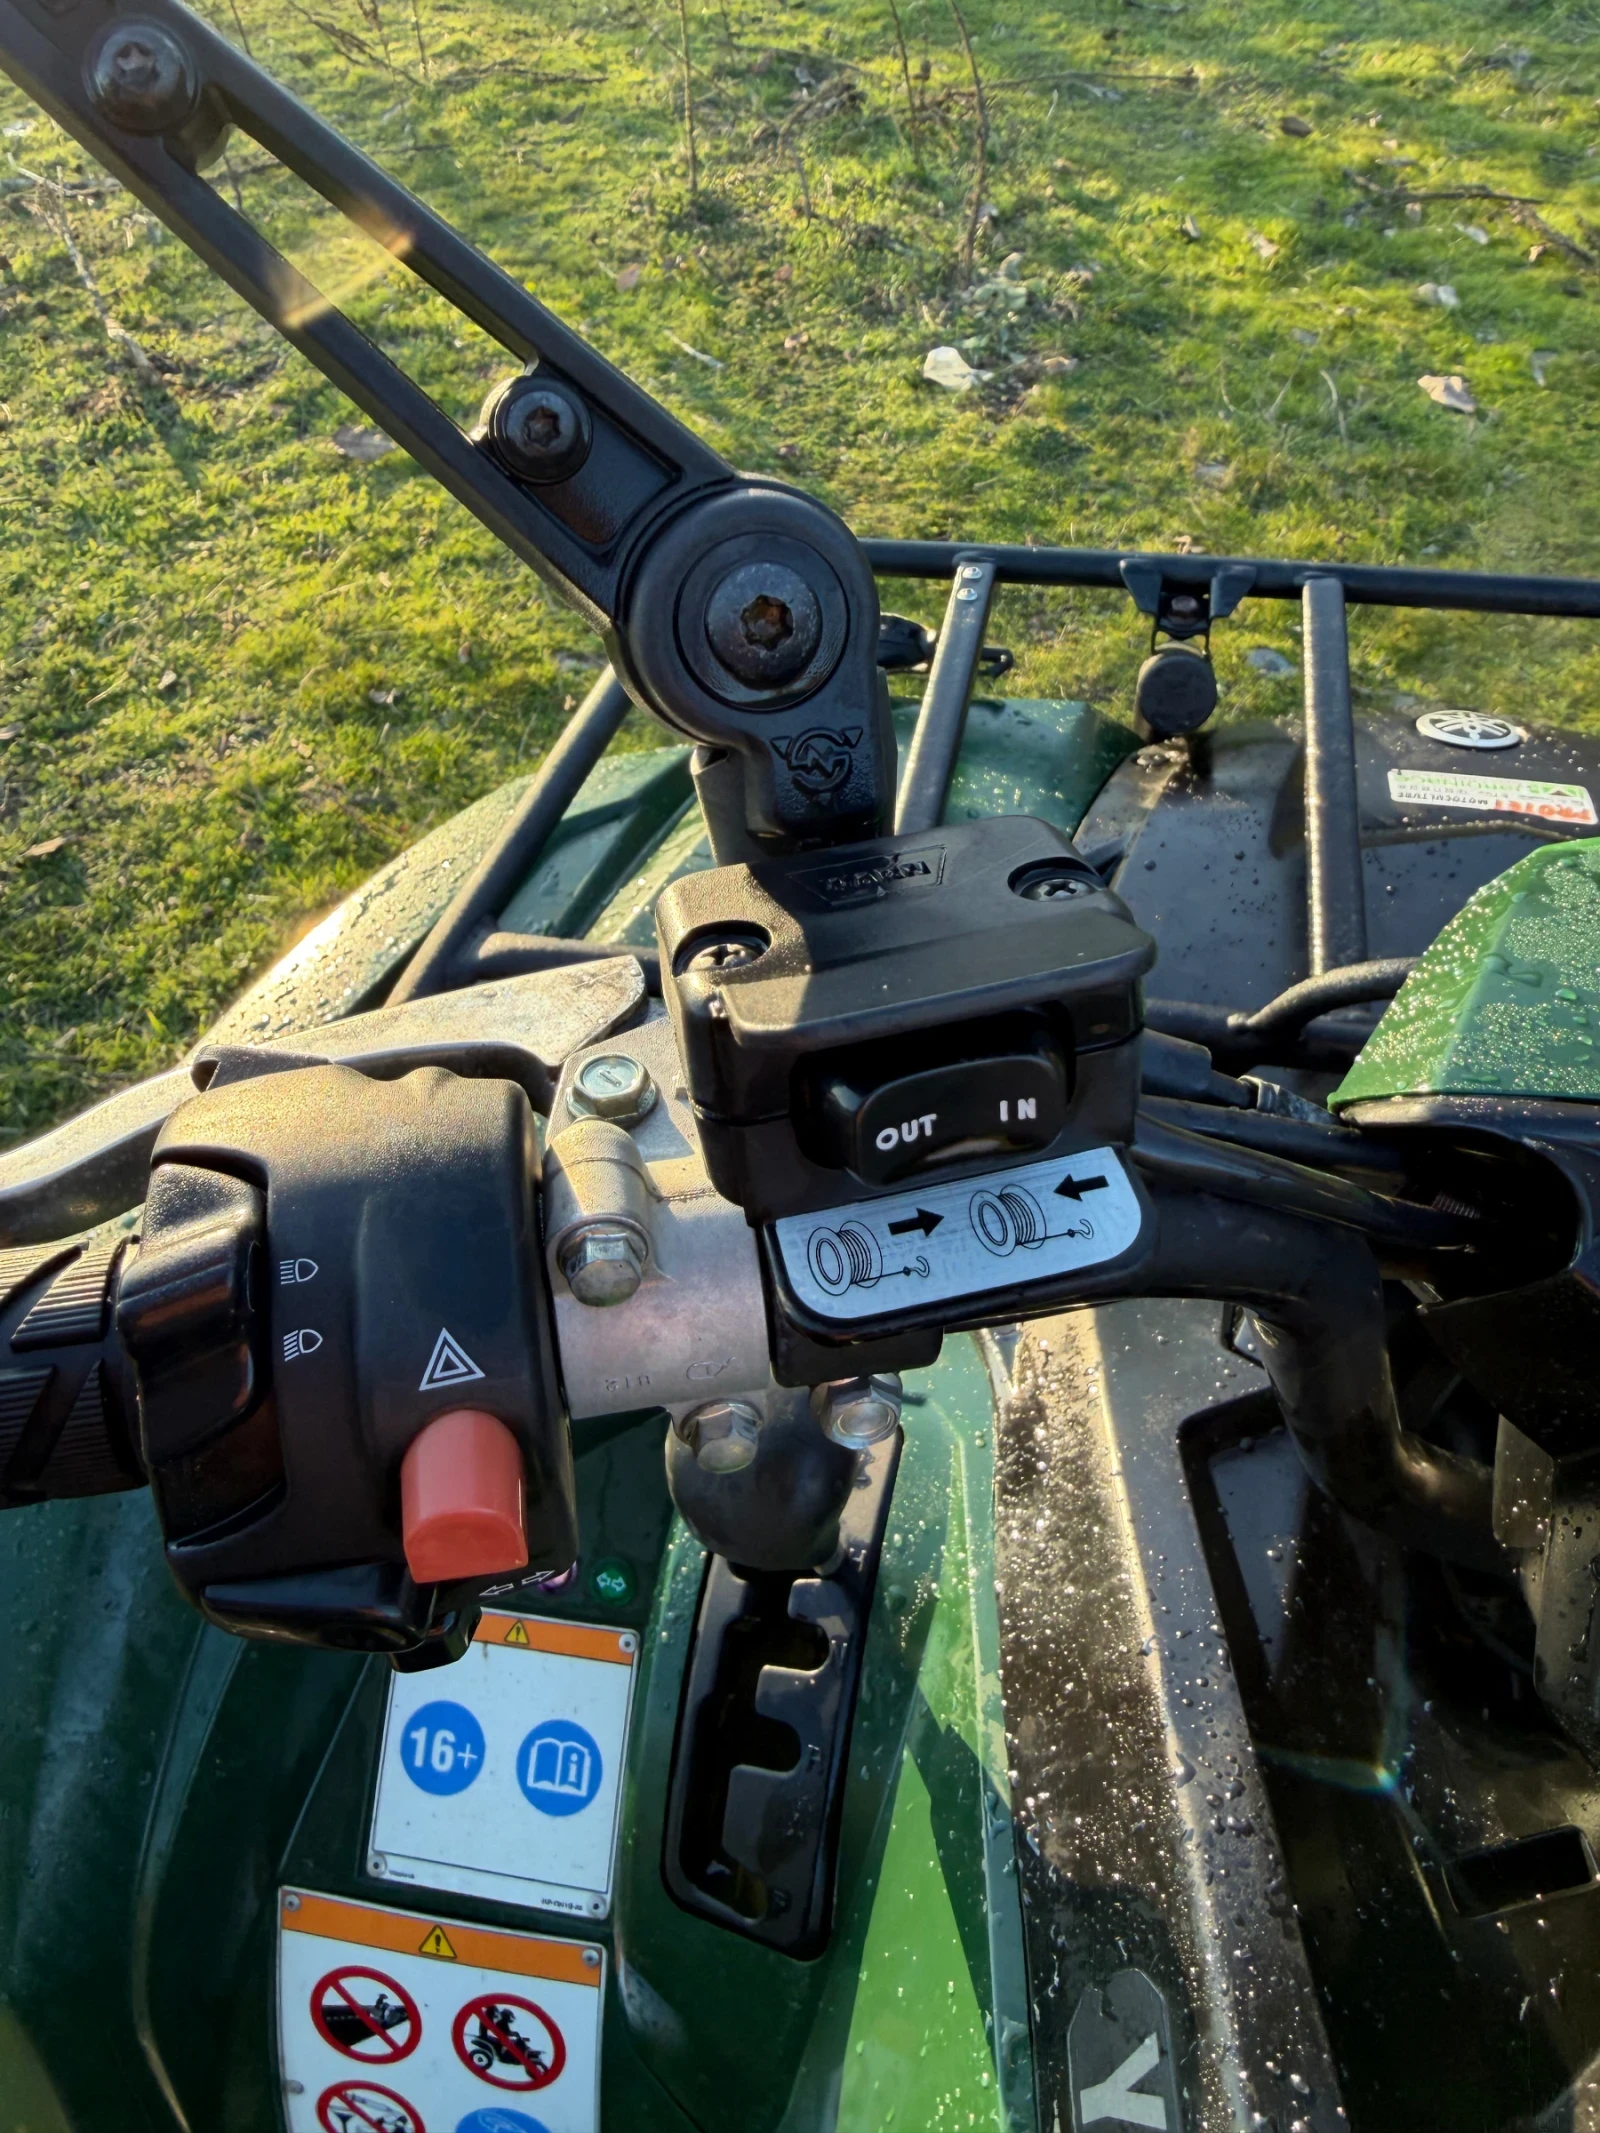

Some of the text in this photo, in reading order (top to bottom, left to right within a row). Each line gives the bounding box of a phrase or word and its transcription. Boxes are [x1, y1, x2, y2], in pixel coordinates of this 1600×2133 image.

[875, 1097, 1037, 1150] OUT IN
[410, 1726, 478, 1773] 16+
